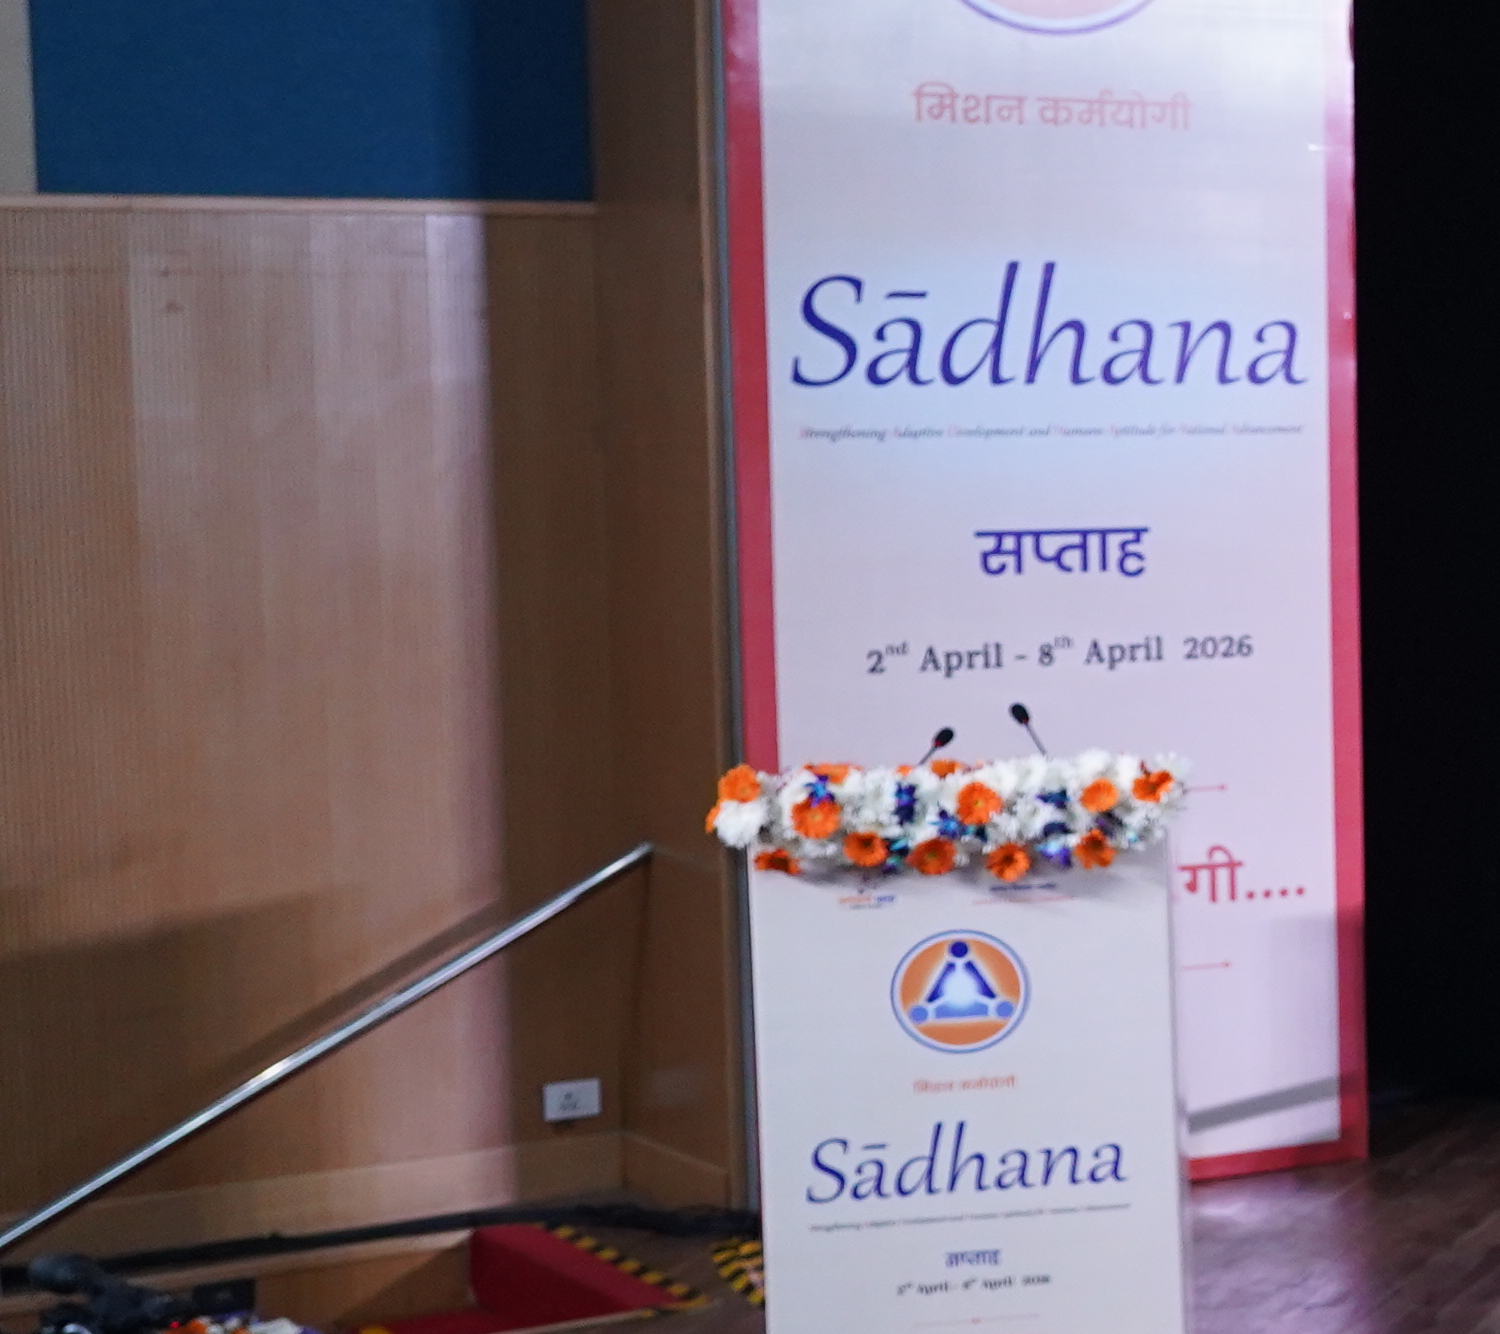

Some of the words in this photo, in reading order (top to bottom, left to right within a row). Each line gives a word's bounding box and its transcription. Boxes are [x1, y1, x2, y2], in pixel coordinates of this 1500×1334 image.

[912, 81, 1030, 126] मिशन
[1034, 88, 1193, 131] कर्मयोगी
[790, 260, 1305, 388] Sādhana
[973, 526, 1150, 578] सप्ताह
[806, 1120, 1126, 1204] Sādhana
